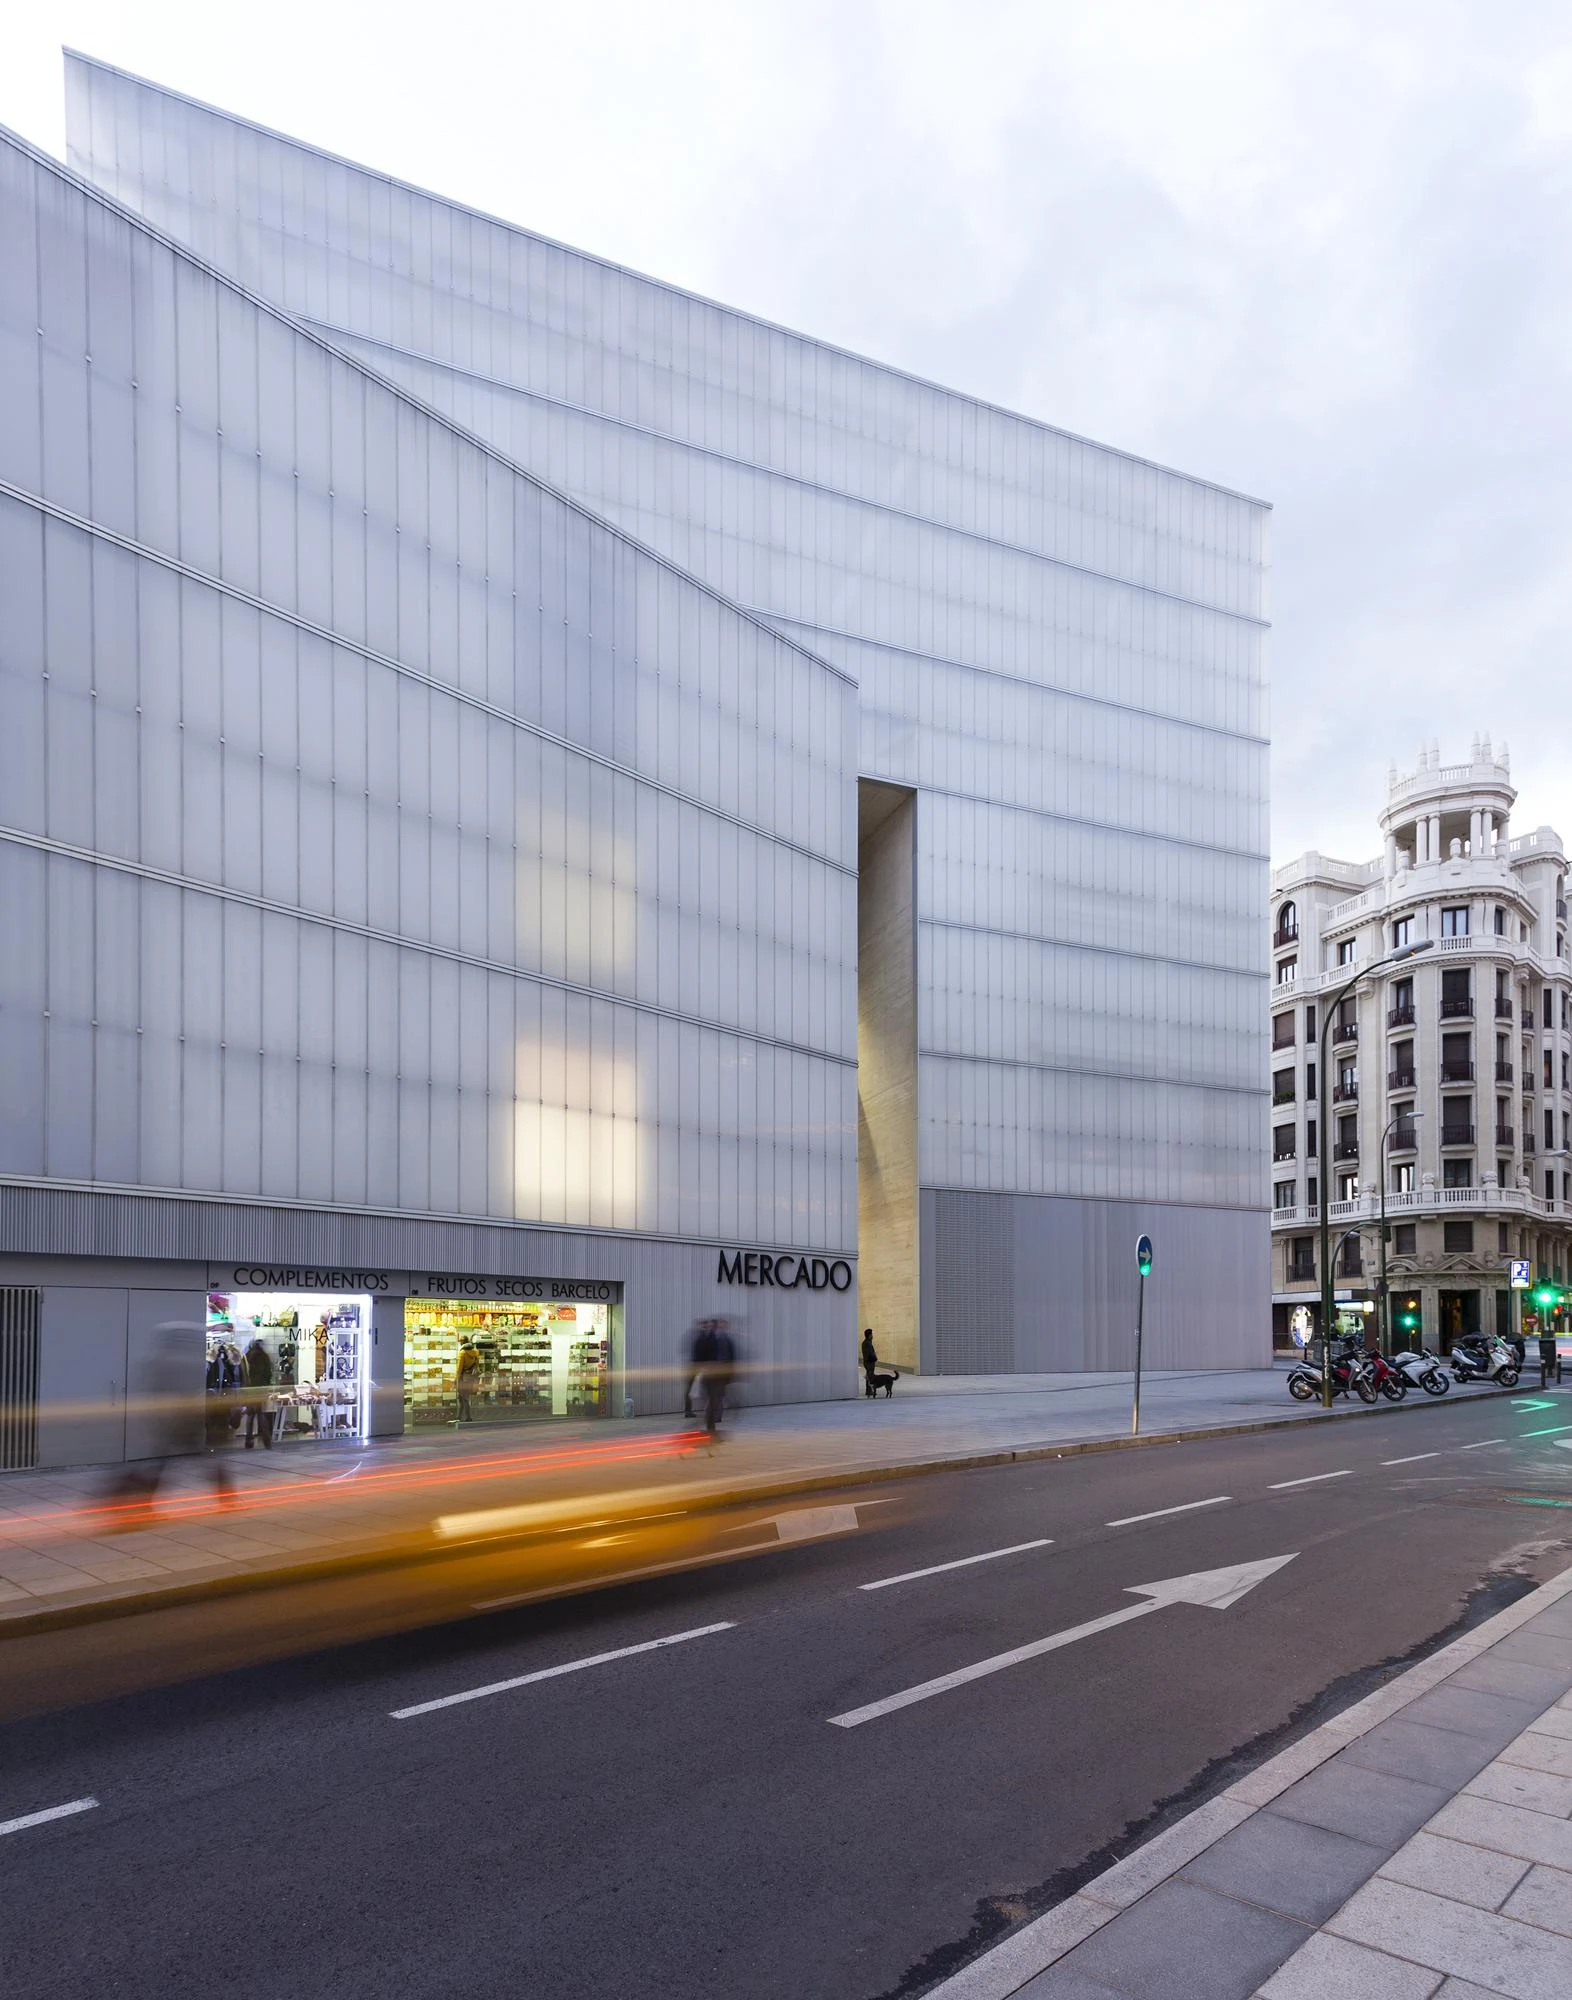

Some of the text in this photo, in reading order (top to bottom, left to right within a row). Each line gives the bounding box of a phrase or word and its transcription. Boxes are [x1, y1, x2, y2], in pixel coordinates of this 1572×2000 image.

[233, 1267, 389, 1291] COMPLEMENTOS
[717, 1250, 852, 1291] MERCADO
[428, 1277, 610, 1300] FRUTOS SECOS BARCELÓ
[289, 1328, 330, 1342] MIKA
